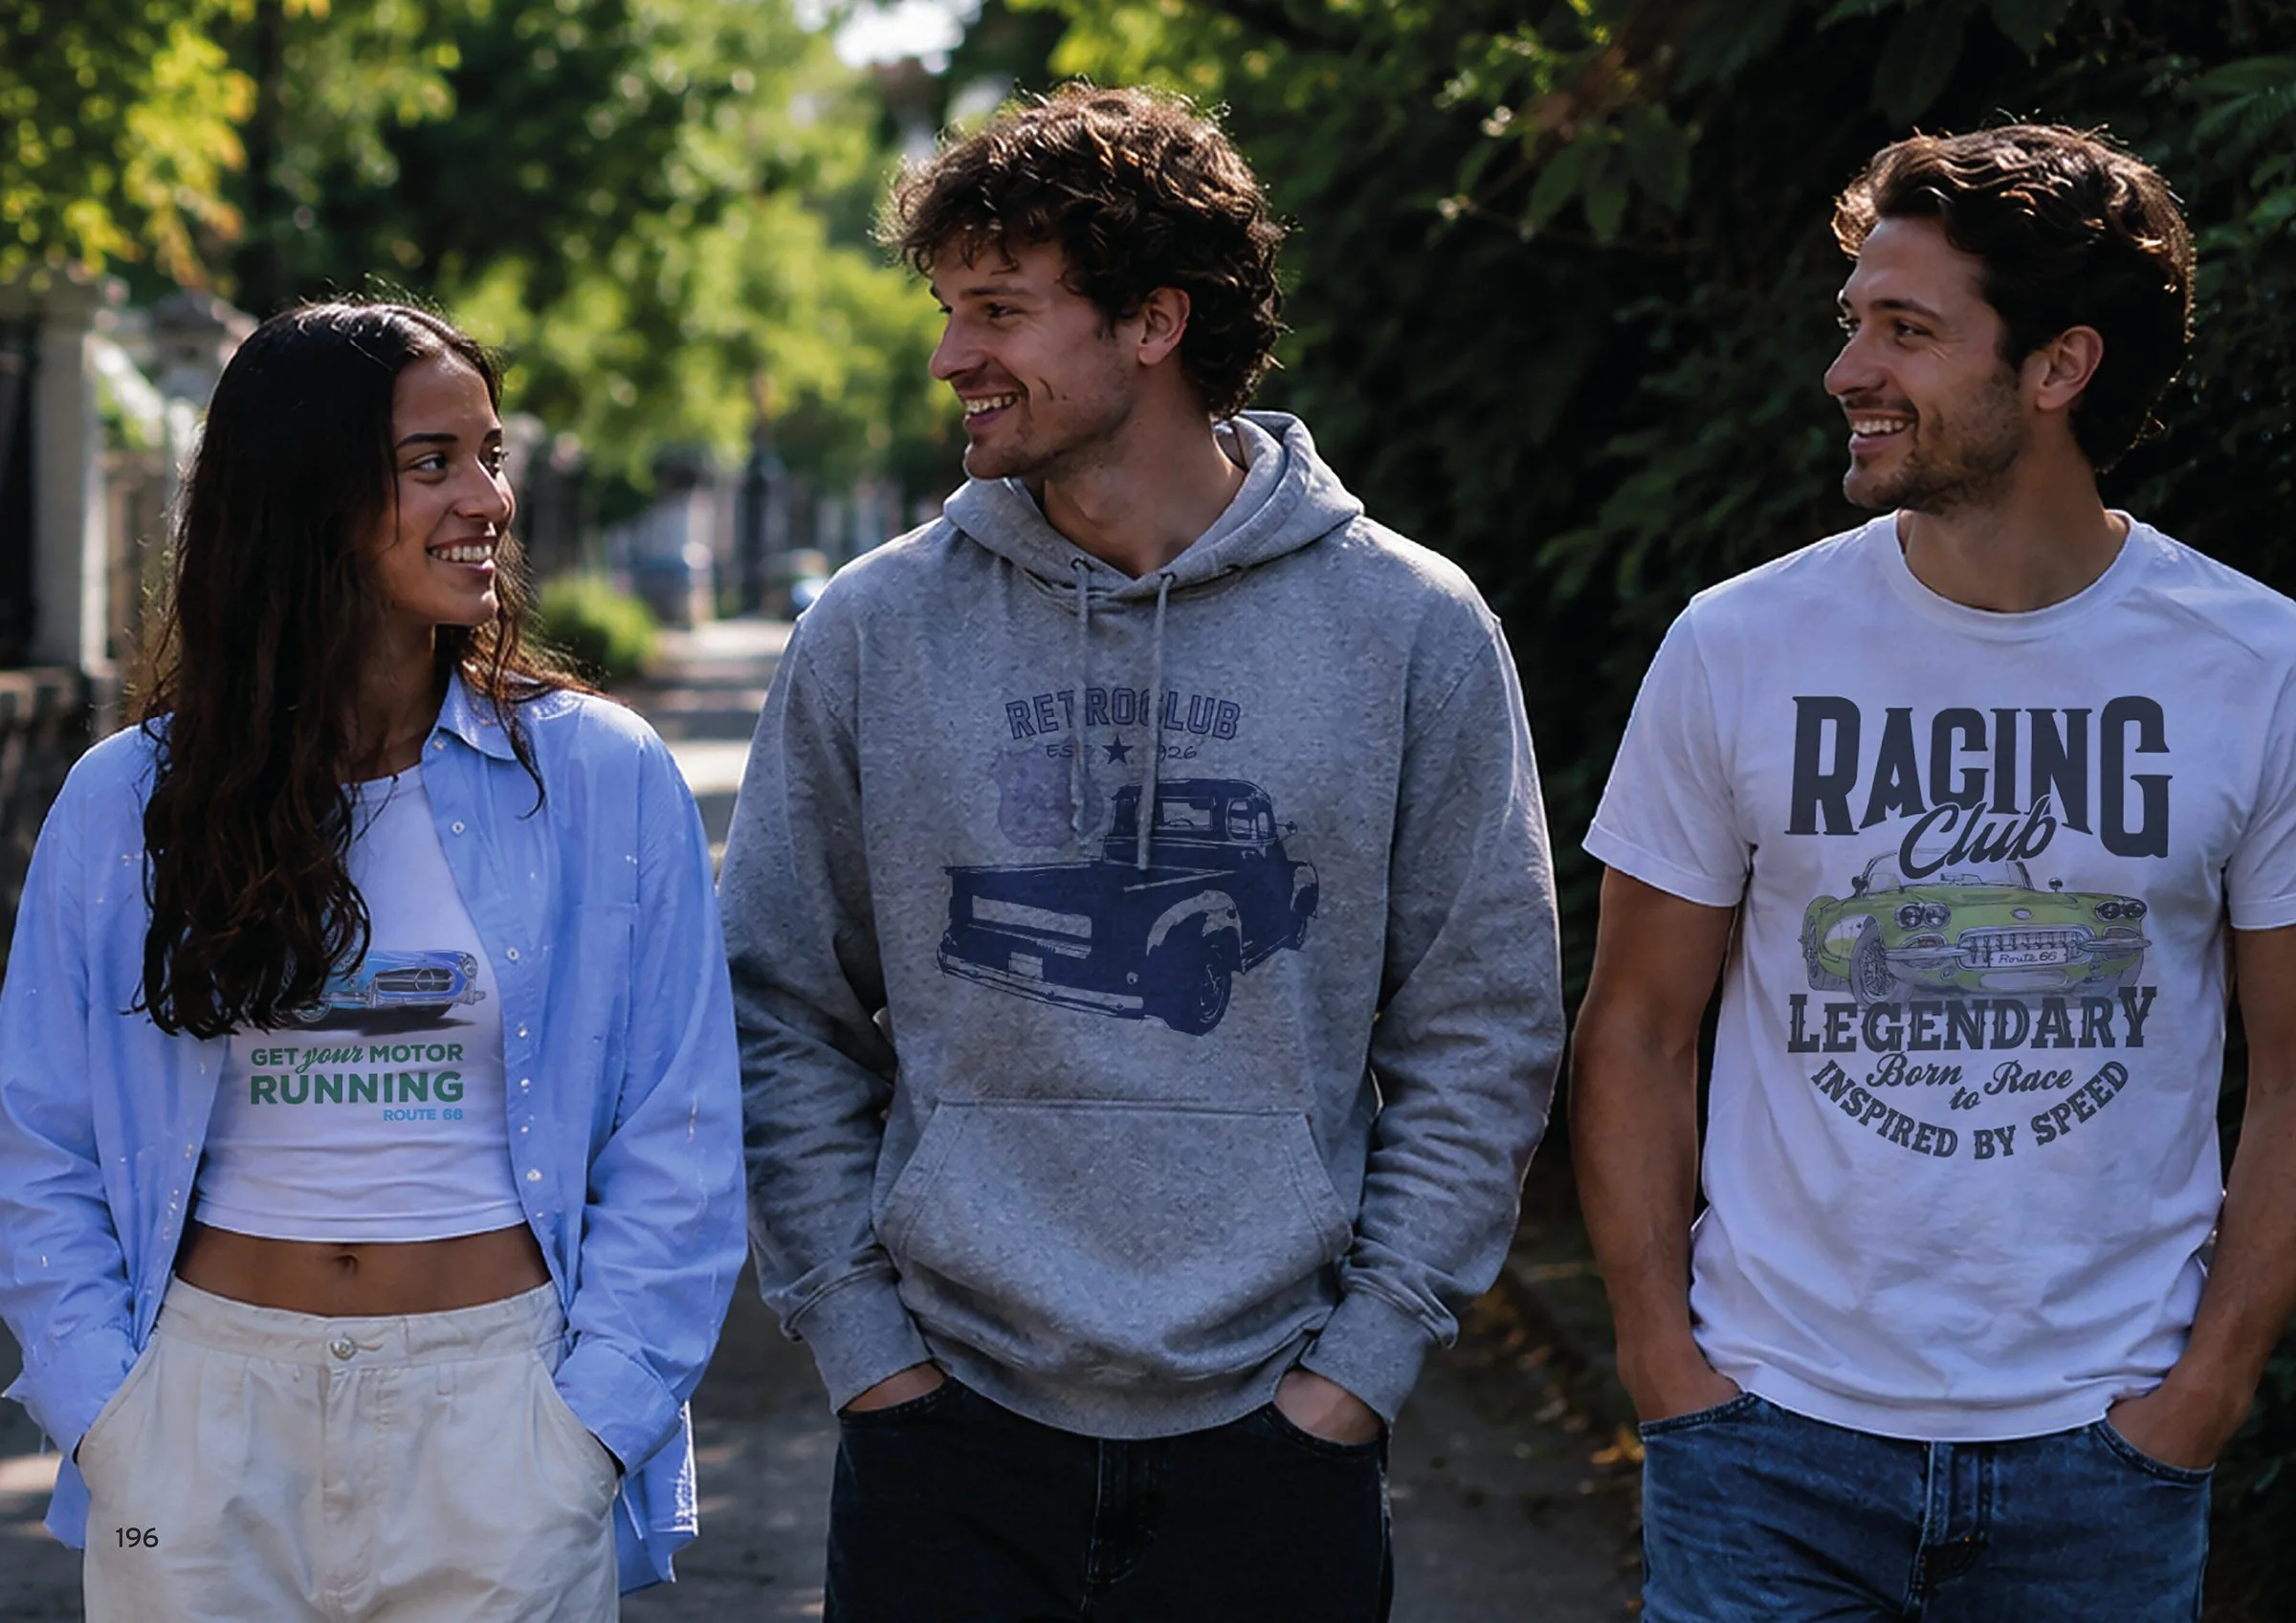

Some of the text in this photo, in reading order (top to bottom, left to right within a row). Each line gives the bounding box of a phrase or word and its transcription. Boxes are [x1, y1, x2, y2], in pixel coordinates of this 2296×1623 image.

[1784, 695, 2173, 858] RACING
[1899, 795, 2057, 879] Club
[2040, 951, 2058, 961] 66
[1787, 986, 2157, 1053] LEGENDARY
[250, 1070, 464, 1105] RUNNING
[251, 1043, 463, 1074] GET your MOTOR
[1866, 1052, 2073, 1110] Born to Race
[383, 1108, 463, 1121] ROUTE 66
[1810, 1060, 2129, 1159] INSPIRED BY SPEED
